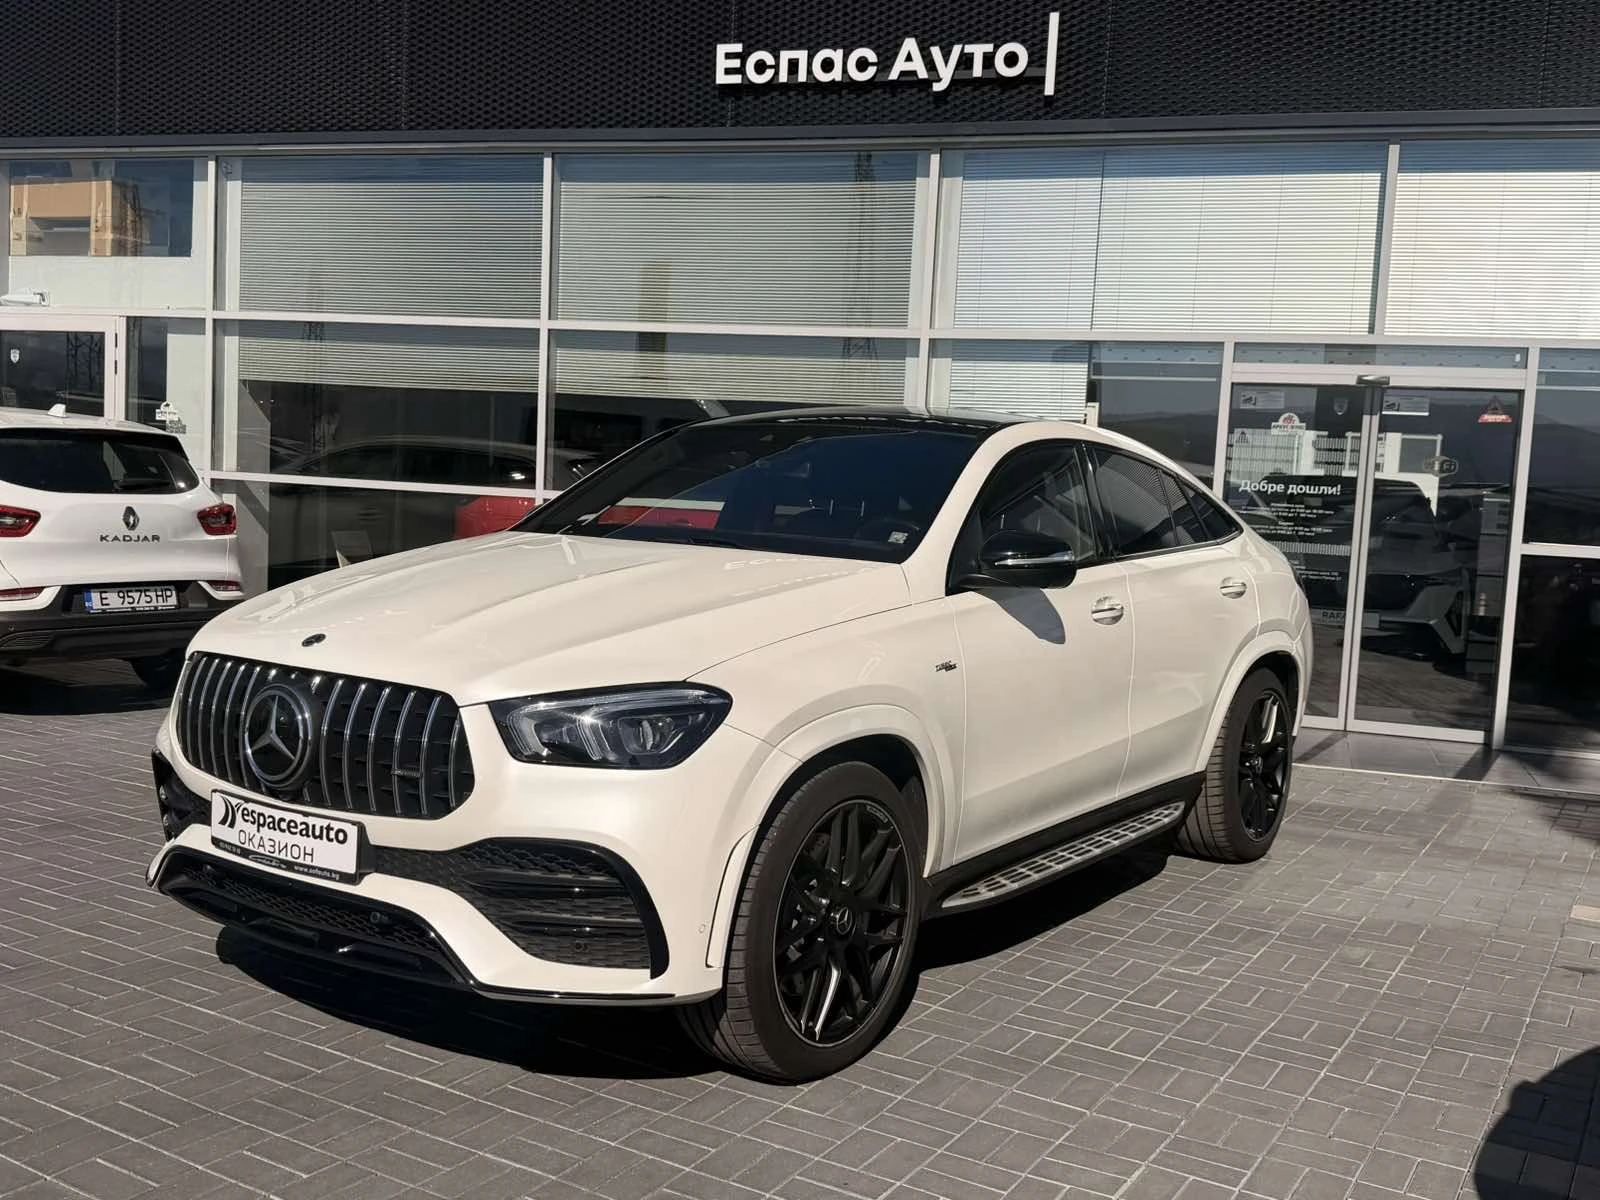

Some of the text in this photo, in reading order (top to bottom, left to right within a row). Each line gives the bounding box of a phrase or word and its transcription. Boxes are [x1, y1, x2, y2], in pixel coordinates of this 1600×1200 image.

[715, 37, 1029, 92] Еспас Ауто
[1238, 479, 1341, 496] Добре дошли!
[99, 534, 161, 543] KADJAR
[99, 588, 174, 607] E 9575 HP
[240, 805, 348, 845] espaceauto
[238, 829, 315, 864] ОКАЗИОН
